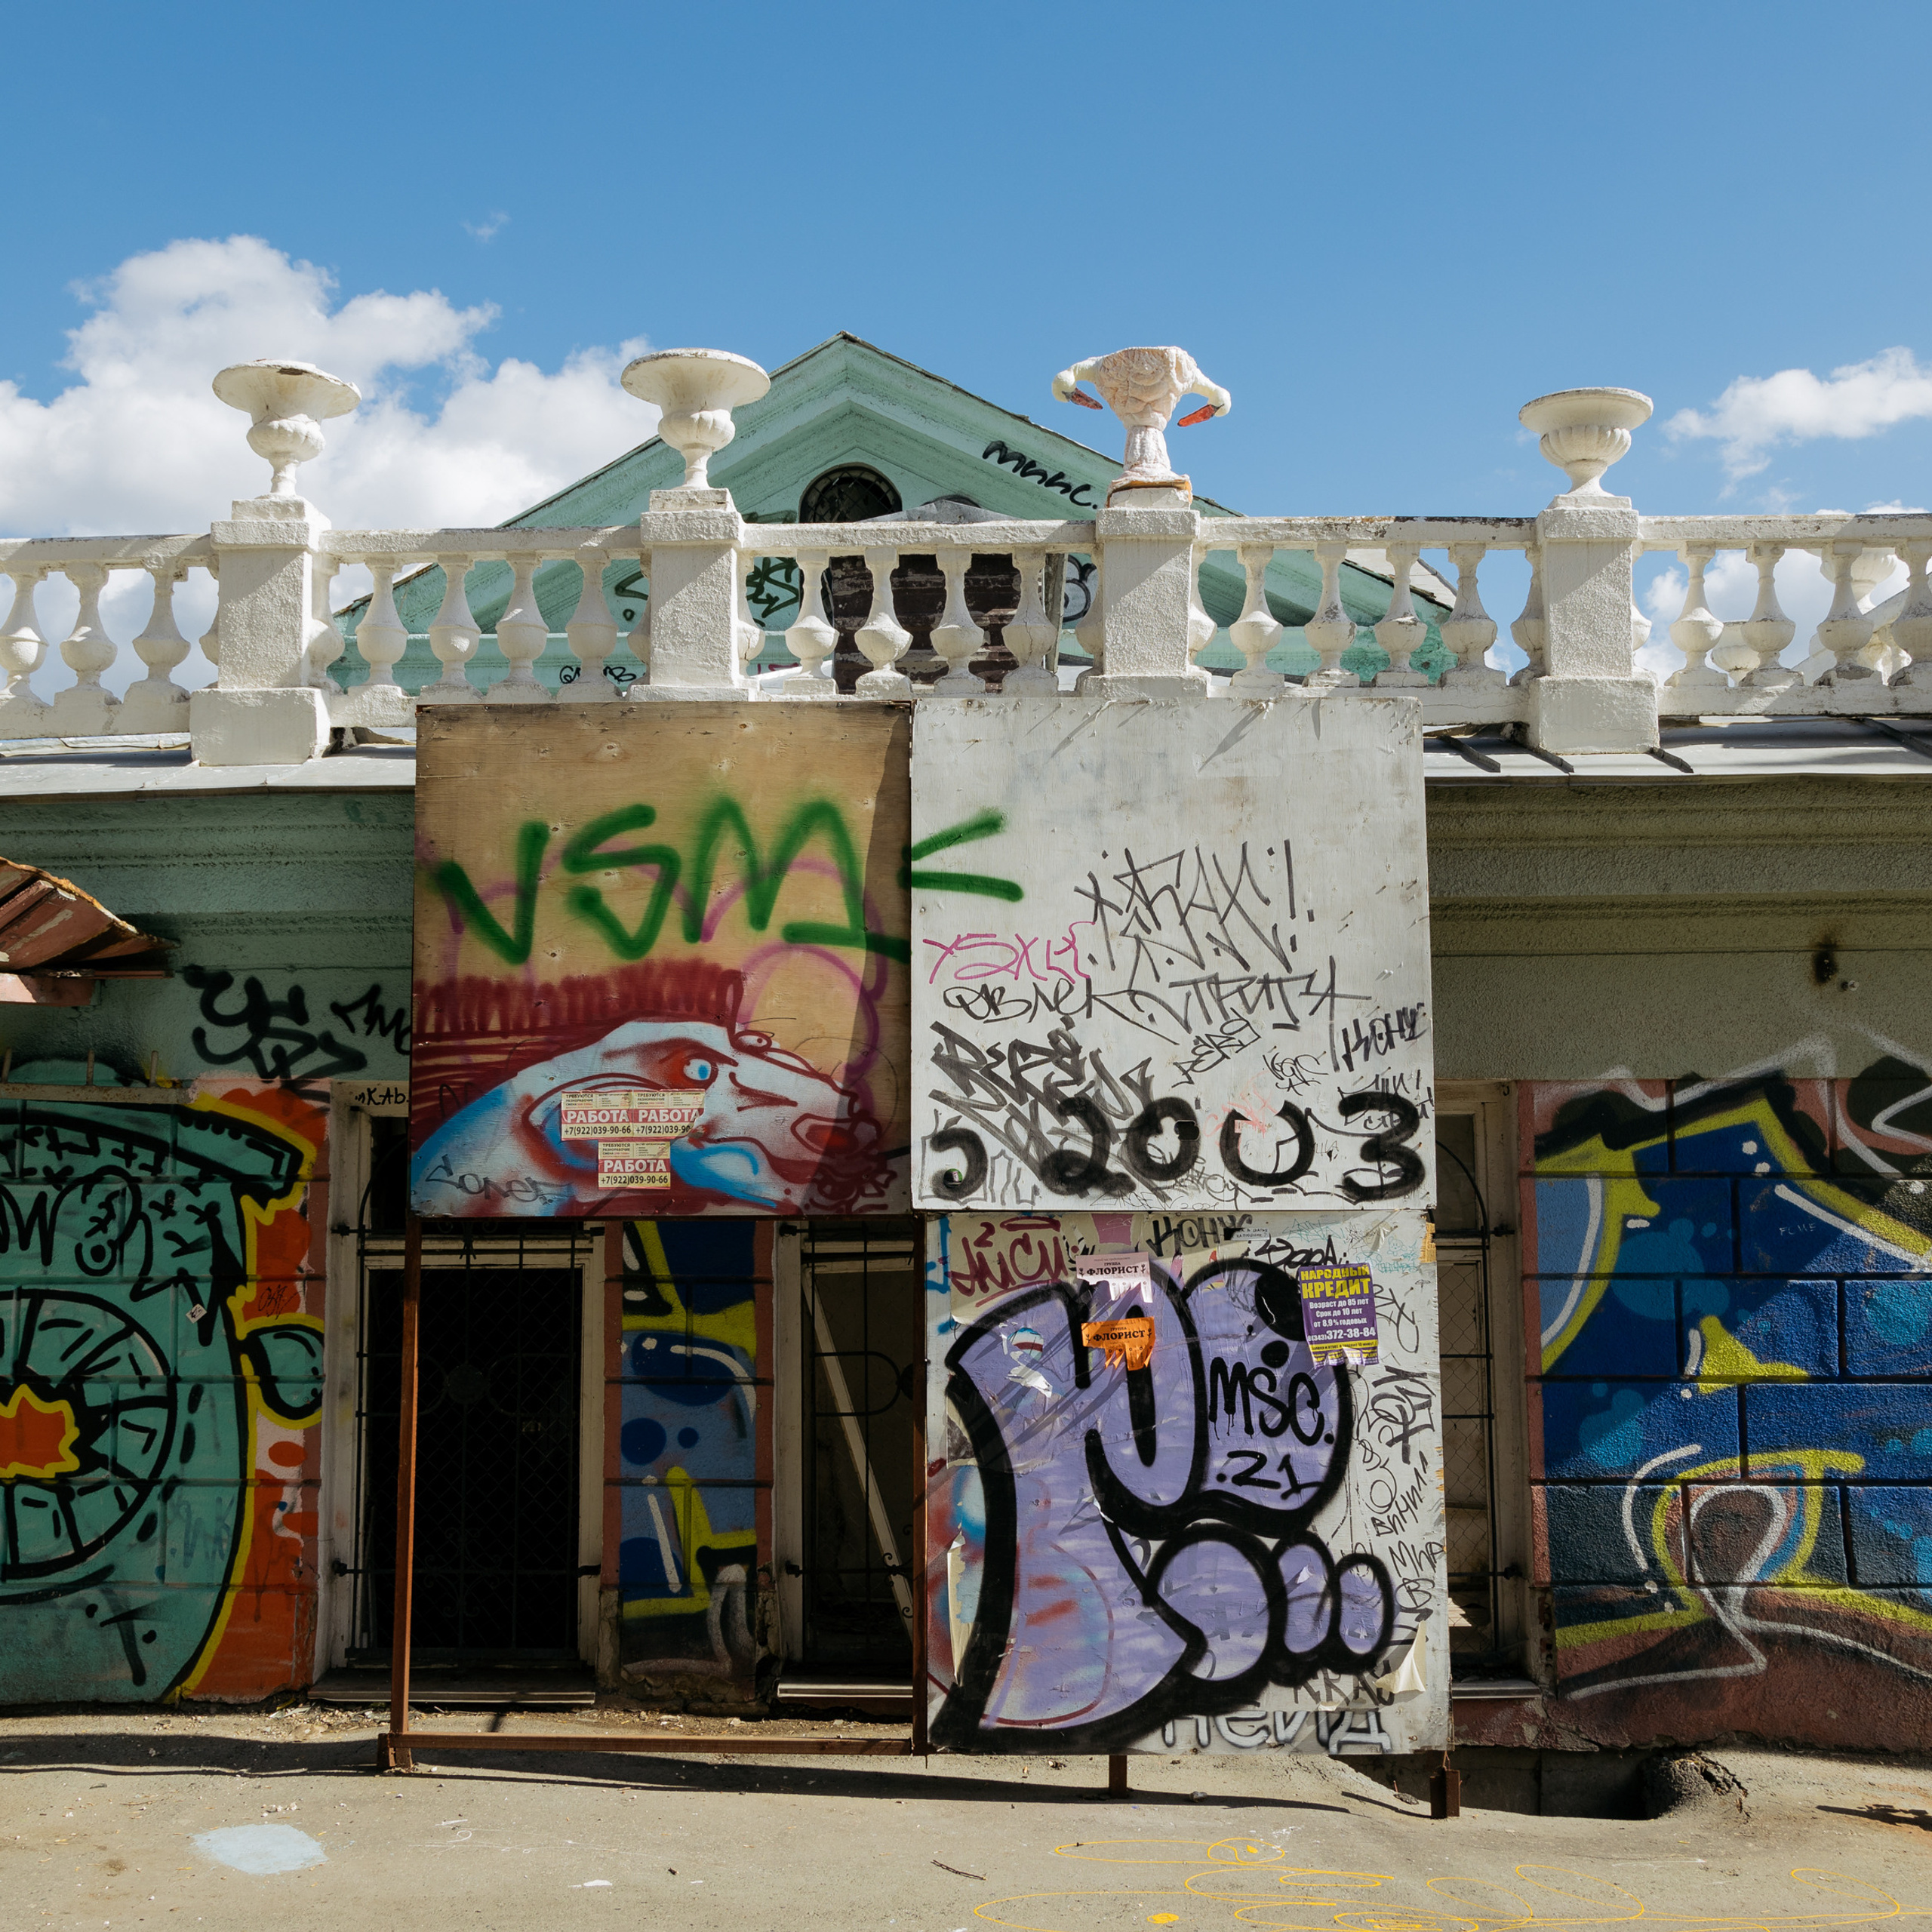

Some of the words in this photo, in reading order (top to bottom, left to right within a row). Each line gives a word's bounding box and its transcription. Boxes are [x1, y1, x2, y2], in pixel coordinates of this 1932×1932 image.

[567, 1110, 629, 1123] РАБОТА
[638, 1109, 700, 1122] РАБОТА
[565, 1125, 631, 1136] +7(922)039-90-66
[605, 1160, 667, 1172] РАБОТА
[601, 1175, 669, 1186] +7(922)039-90-66
[1087, 1266, 1139, 1275] ФЛОРИСТ
[1300, 1264, 1370, 1281] НАРОДНЫЙ
[1301, 1278, 1371, 1299] КРЕДИТ
[1309, 1301, 1337, 1309] Возраст
[1093, 1331, 1145, 1341] ФЛОРИСТ
